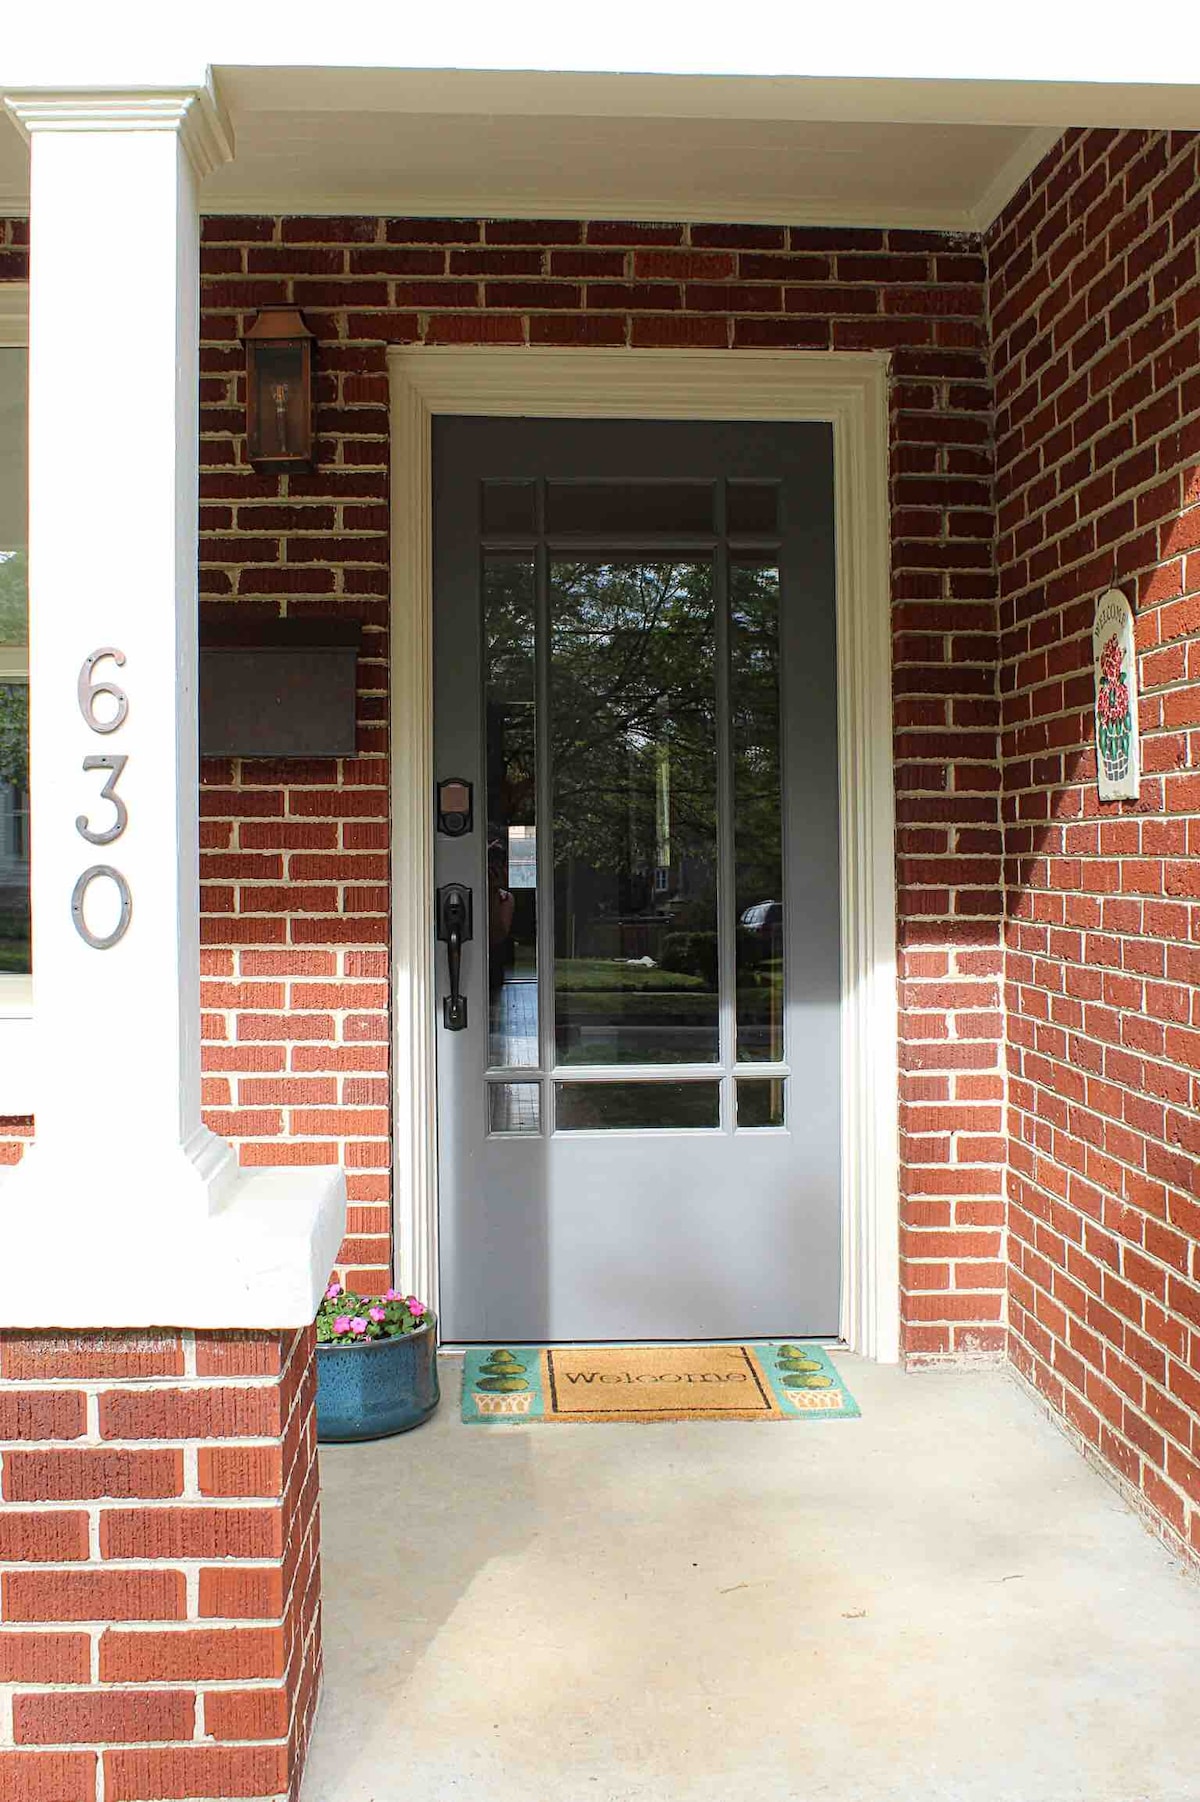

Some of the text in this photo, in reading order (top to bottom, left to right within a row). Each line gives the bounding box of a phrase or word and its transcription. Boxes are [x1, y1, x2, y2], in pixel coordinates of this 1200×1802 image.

[1095, 604, 1126, 637] WELCOME
[71, 646, 132, 950] 630
[564, 1371, 747, 1384] Welcome
